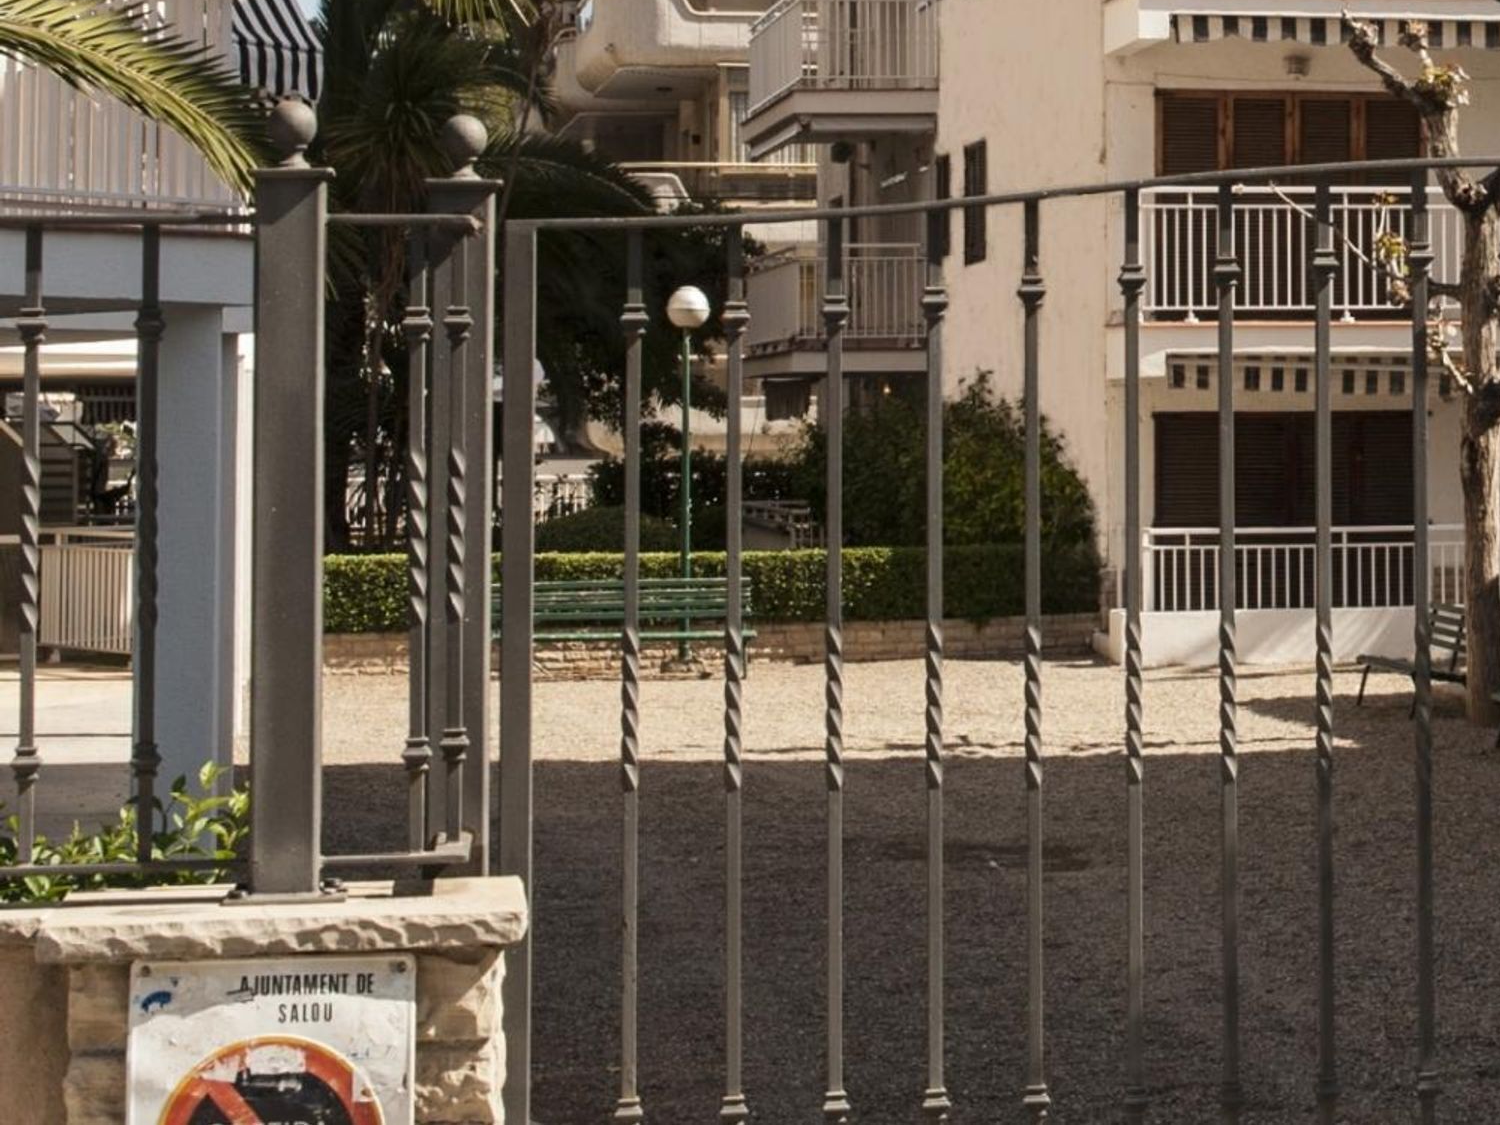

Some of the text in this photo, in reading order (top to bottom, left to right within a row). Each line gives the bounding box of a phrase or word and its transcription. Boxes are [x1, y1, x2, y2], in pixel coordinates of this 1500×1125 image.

[240, 973, 374, 995] AJUNTAMENT DE
[278, 1002, 333, 1023] SALOU
